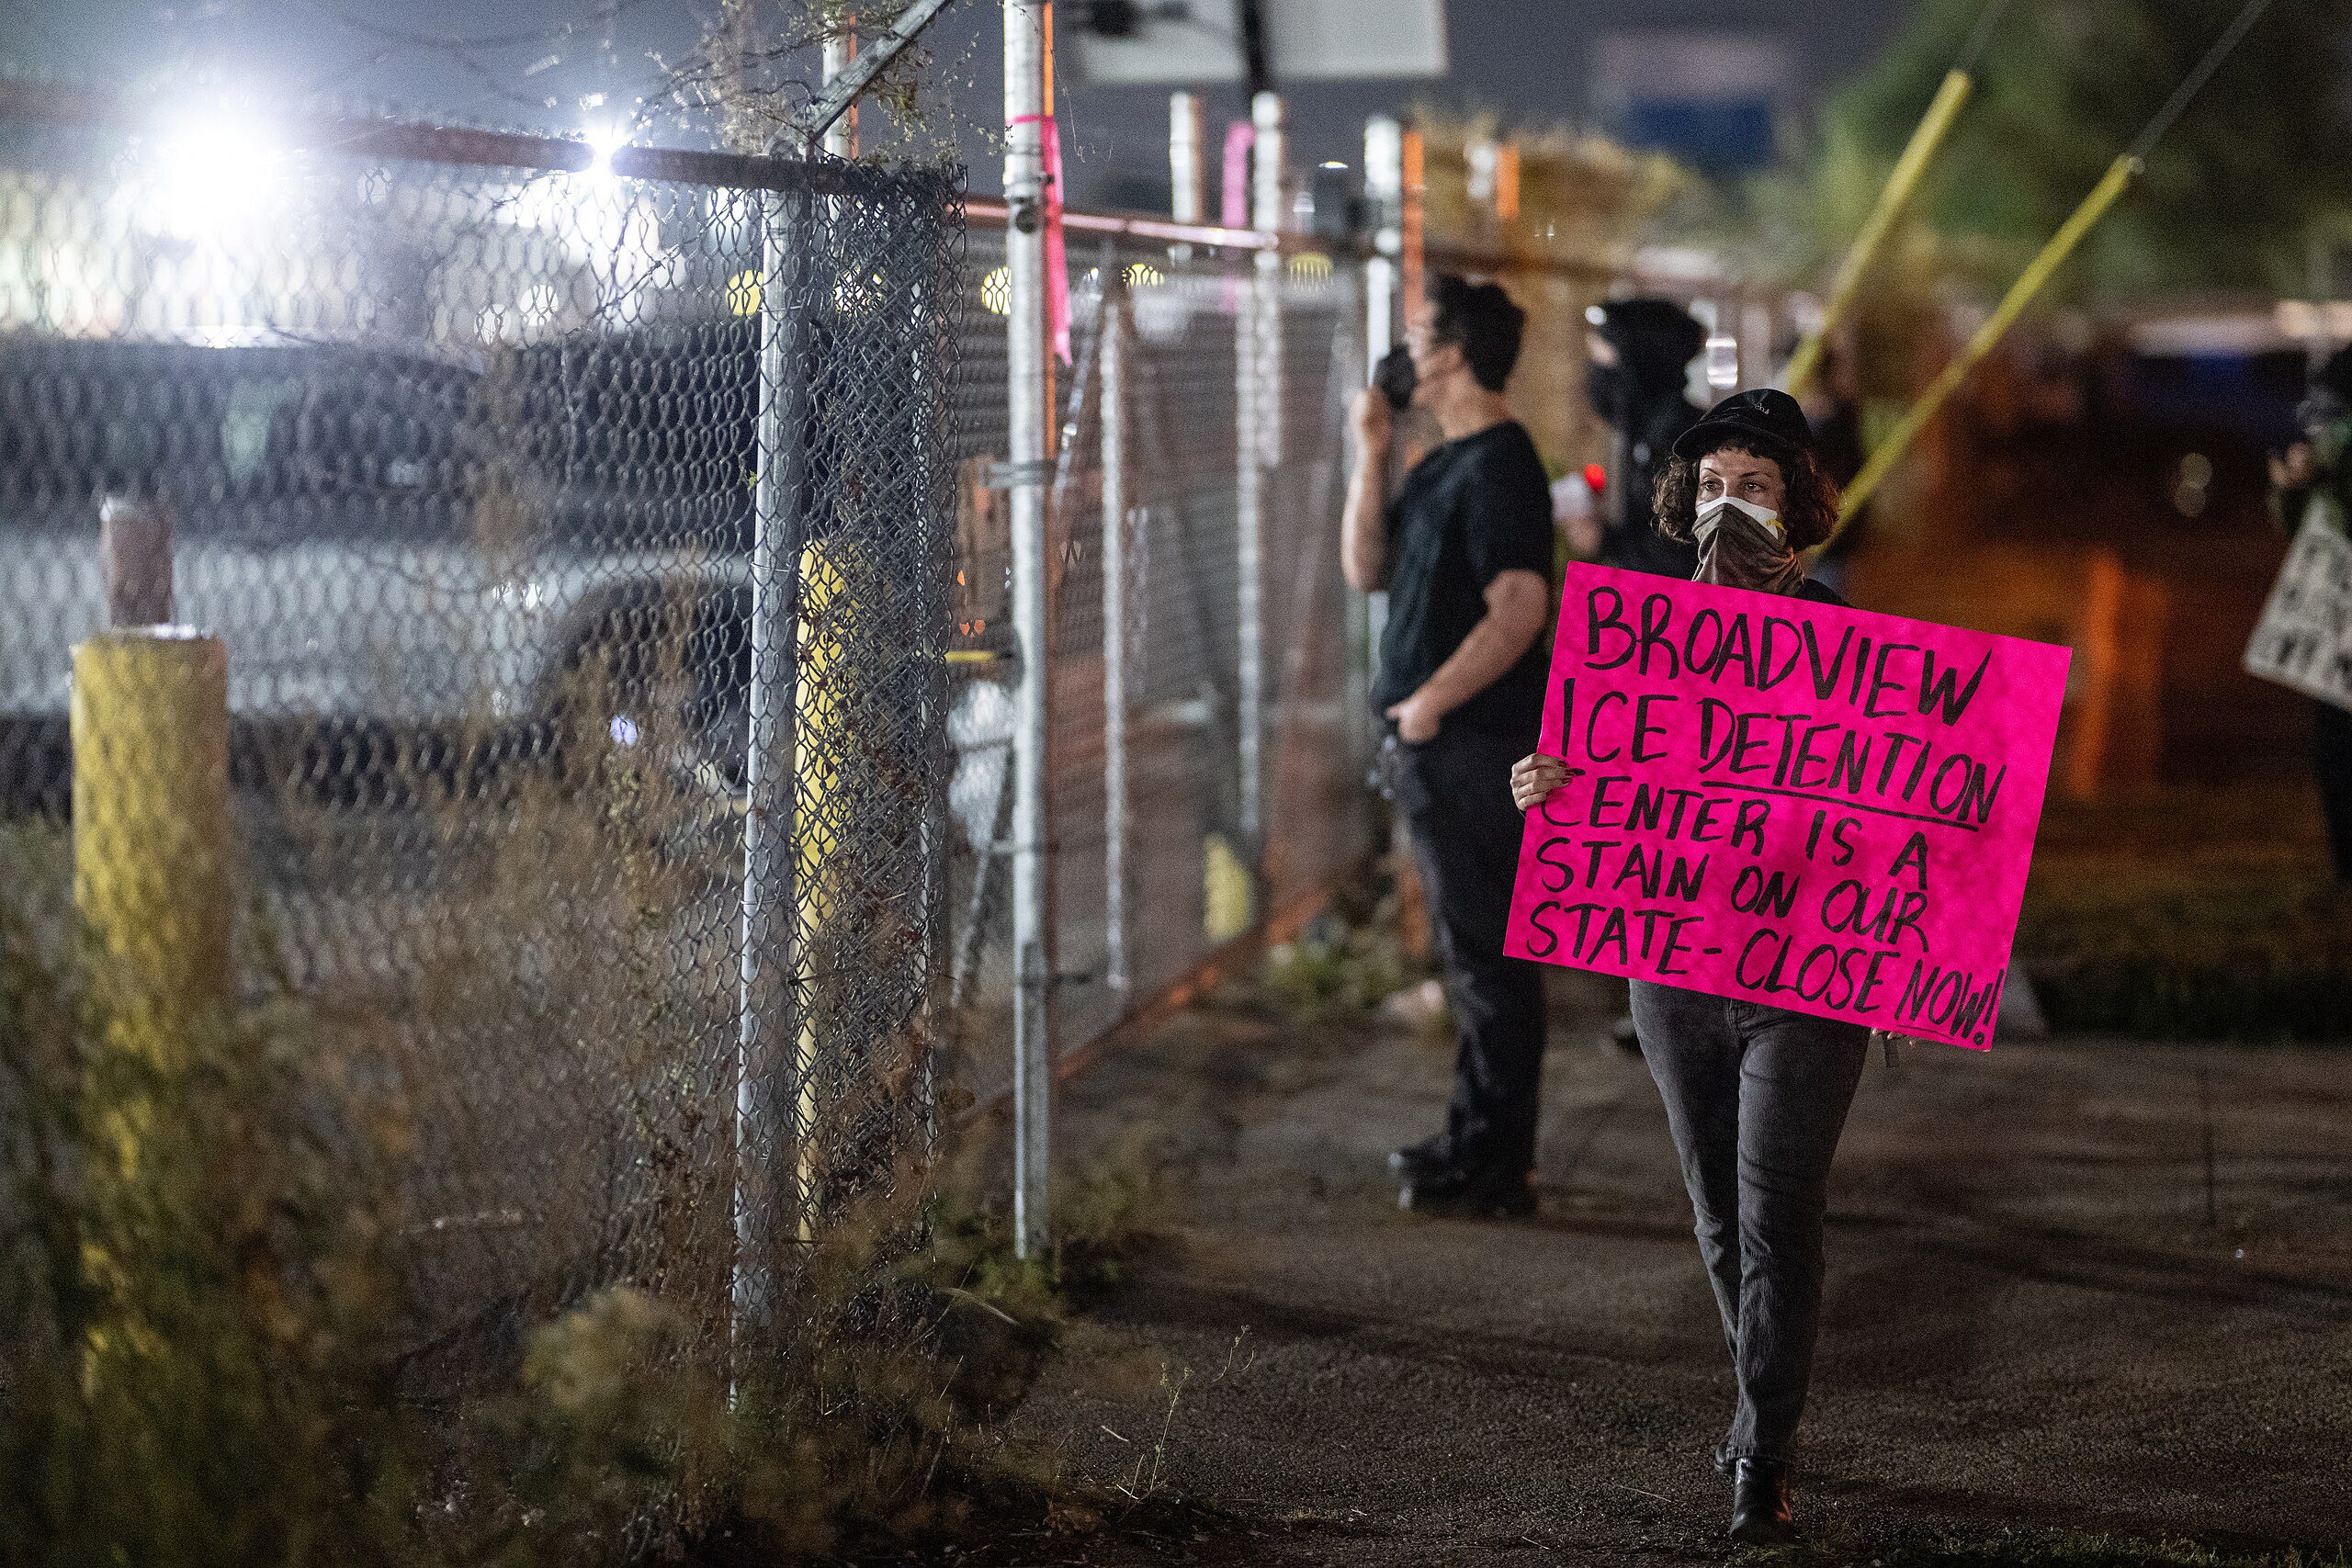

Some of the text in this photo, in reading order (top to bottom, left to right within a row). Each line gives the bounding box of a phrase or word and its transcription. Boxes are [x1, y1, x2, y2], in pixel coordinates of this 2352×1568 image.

[1584, 586, 1992, 727] BROADVIEW
[1562, 678, 2007, 824] ICE DETENTION
[1536, 837, 1929, 953] STAIN ON OUR
[1805, 810, 1862, 866] IS
[1888, 832, 1929, 891] A
[1736, 928, 1901, 1013] CLOSE
[1894, 959, 2005, 1045] NOW!
